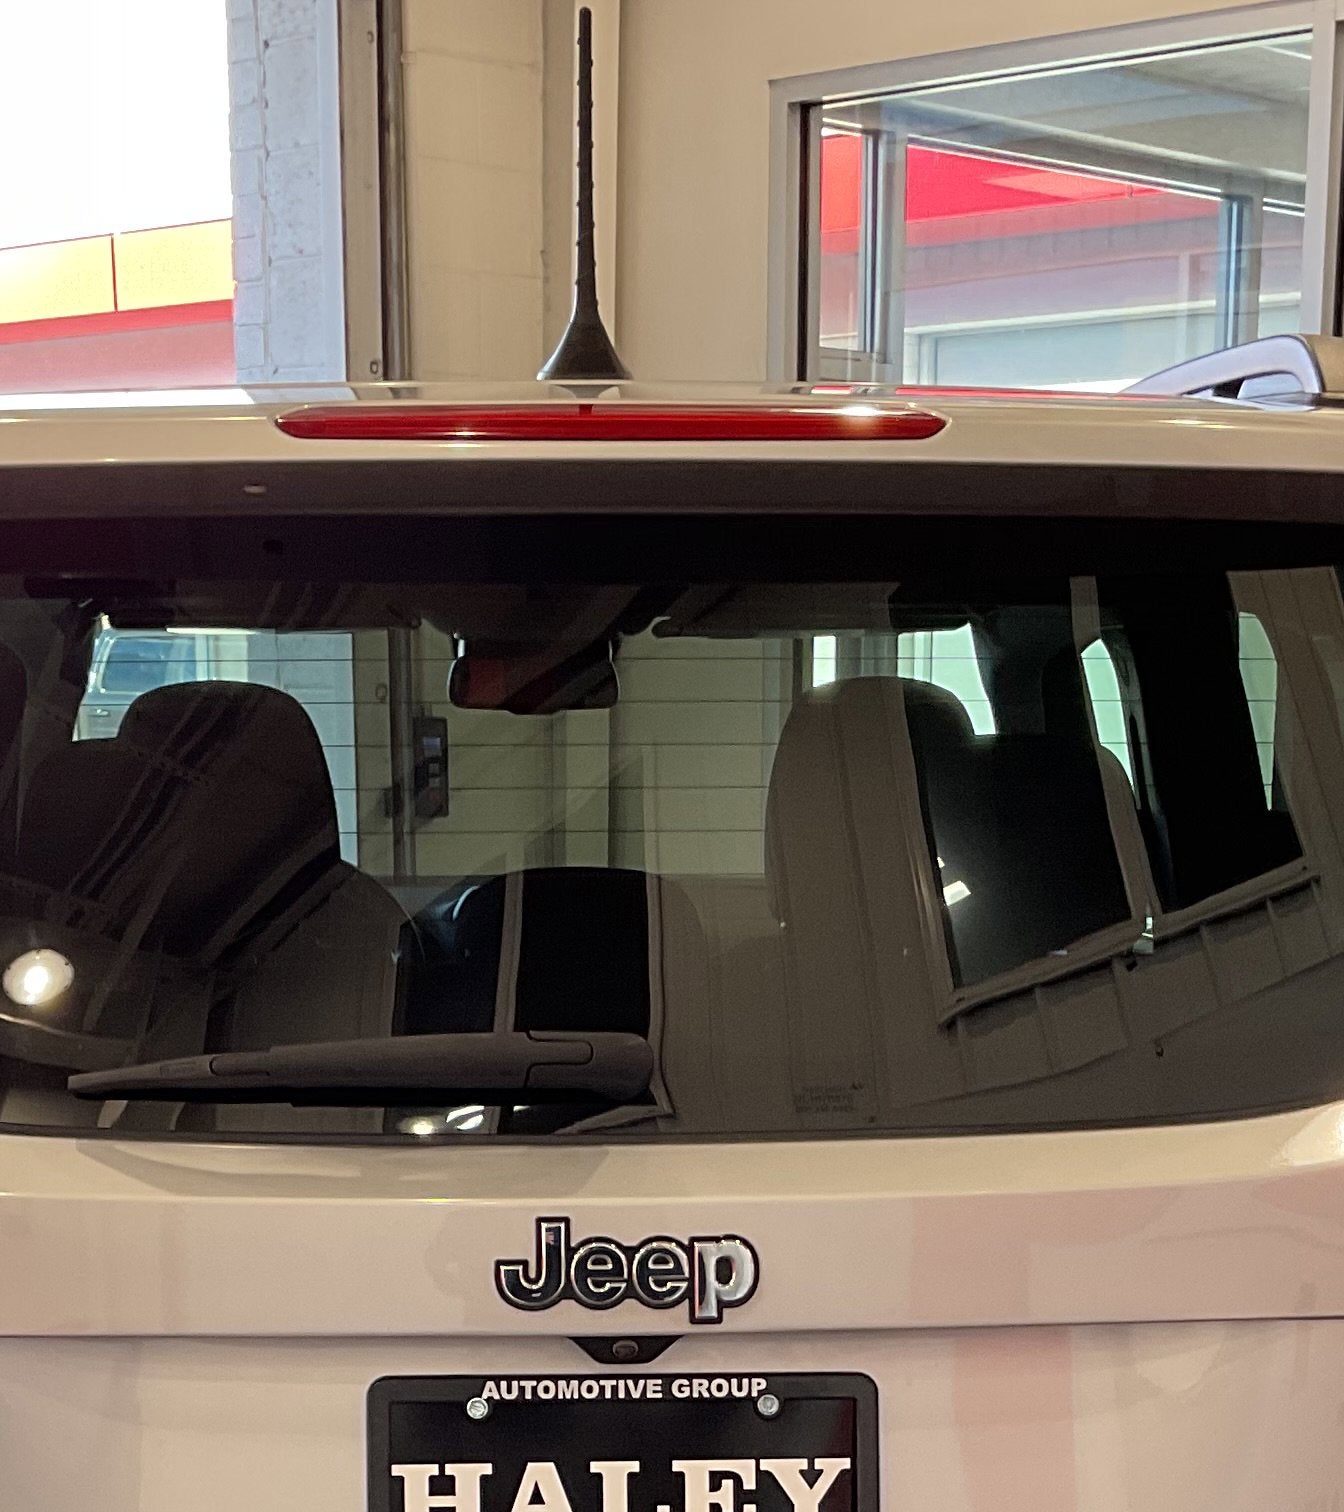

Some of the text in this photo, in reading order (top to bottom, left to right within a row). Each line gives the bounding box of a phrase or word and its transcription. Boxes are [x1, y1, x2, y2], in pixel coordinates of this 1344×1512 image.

[495, 1217, 759, 1324] Jeep
[481, 1377, 768, 1400] AUTOMOTIVE GROUP
